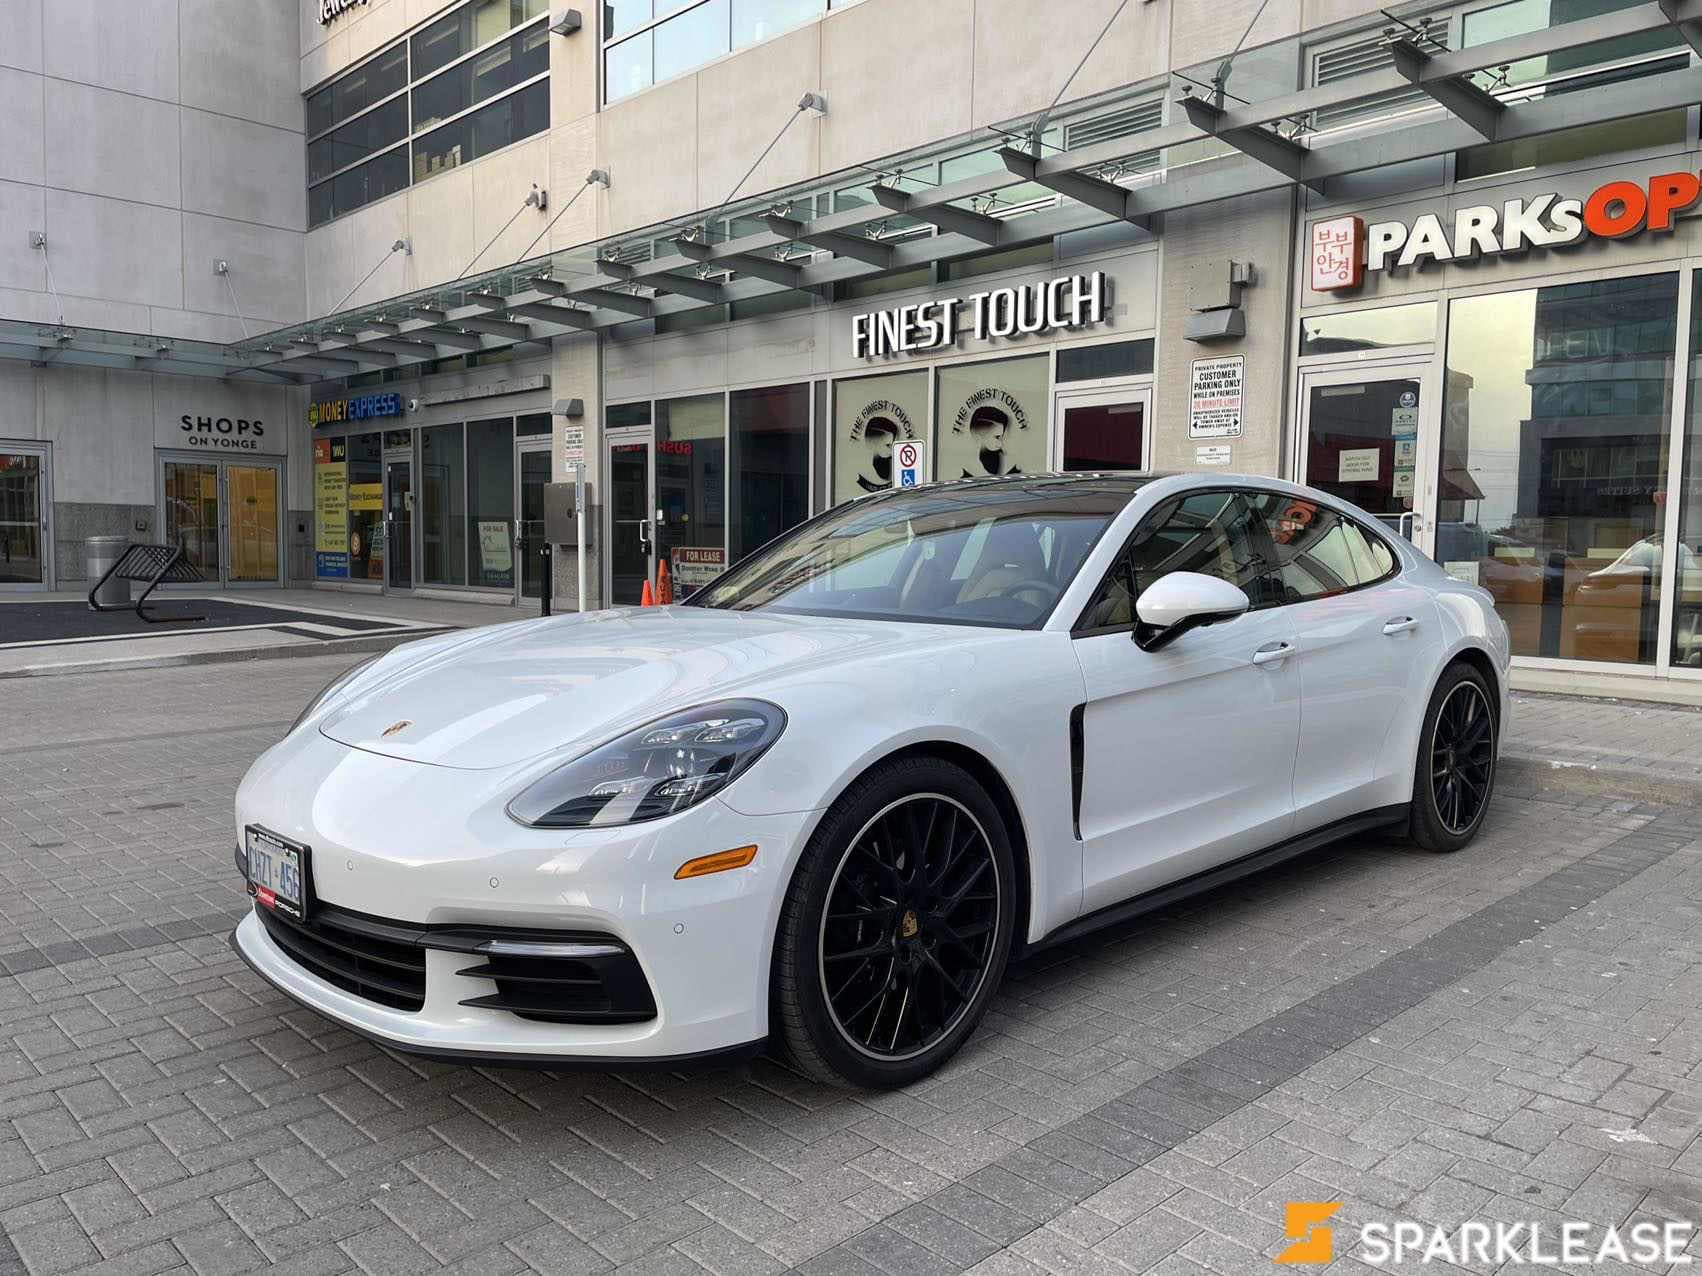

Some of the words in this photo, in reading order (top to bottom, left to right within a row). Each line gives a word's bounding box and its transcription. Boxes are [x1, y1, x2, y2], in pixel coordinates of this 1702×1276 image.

[1315, 229, 1352, 255] 부부
[1317, 252, 1349, 280] 안경
[852, 298, 960, 358] FINEST
[969, 271, 1104, 340] TOUCH
[1194, 381, 1222, 390] PARKING
[1224, 379, 1241, 388] ONLY
[1199, 370, 1236, 381] CUSTOMER
[1193, 391, 1208, 399] WHILE
[1216, 389, 1240, 397] PREMISES
[850, 416, 863, 440] THE
[861, 400, 888, 418] FINEST
[891, 403, 914, 439] TOUCH
[952, 407, 967, 434] THE
[966, 388, 997, 409] FINEST
[999, 391, 1027, 430] TOUCH
[181, 414, 264, 436] SHOPS
[188, 436, 208, 446] ON
[211, 438, 257, 449] YONGE
[686, 551, 700, 560] FOR
[700, 551, 721, 562] LEASE
